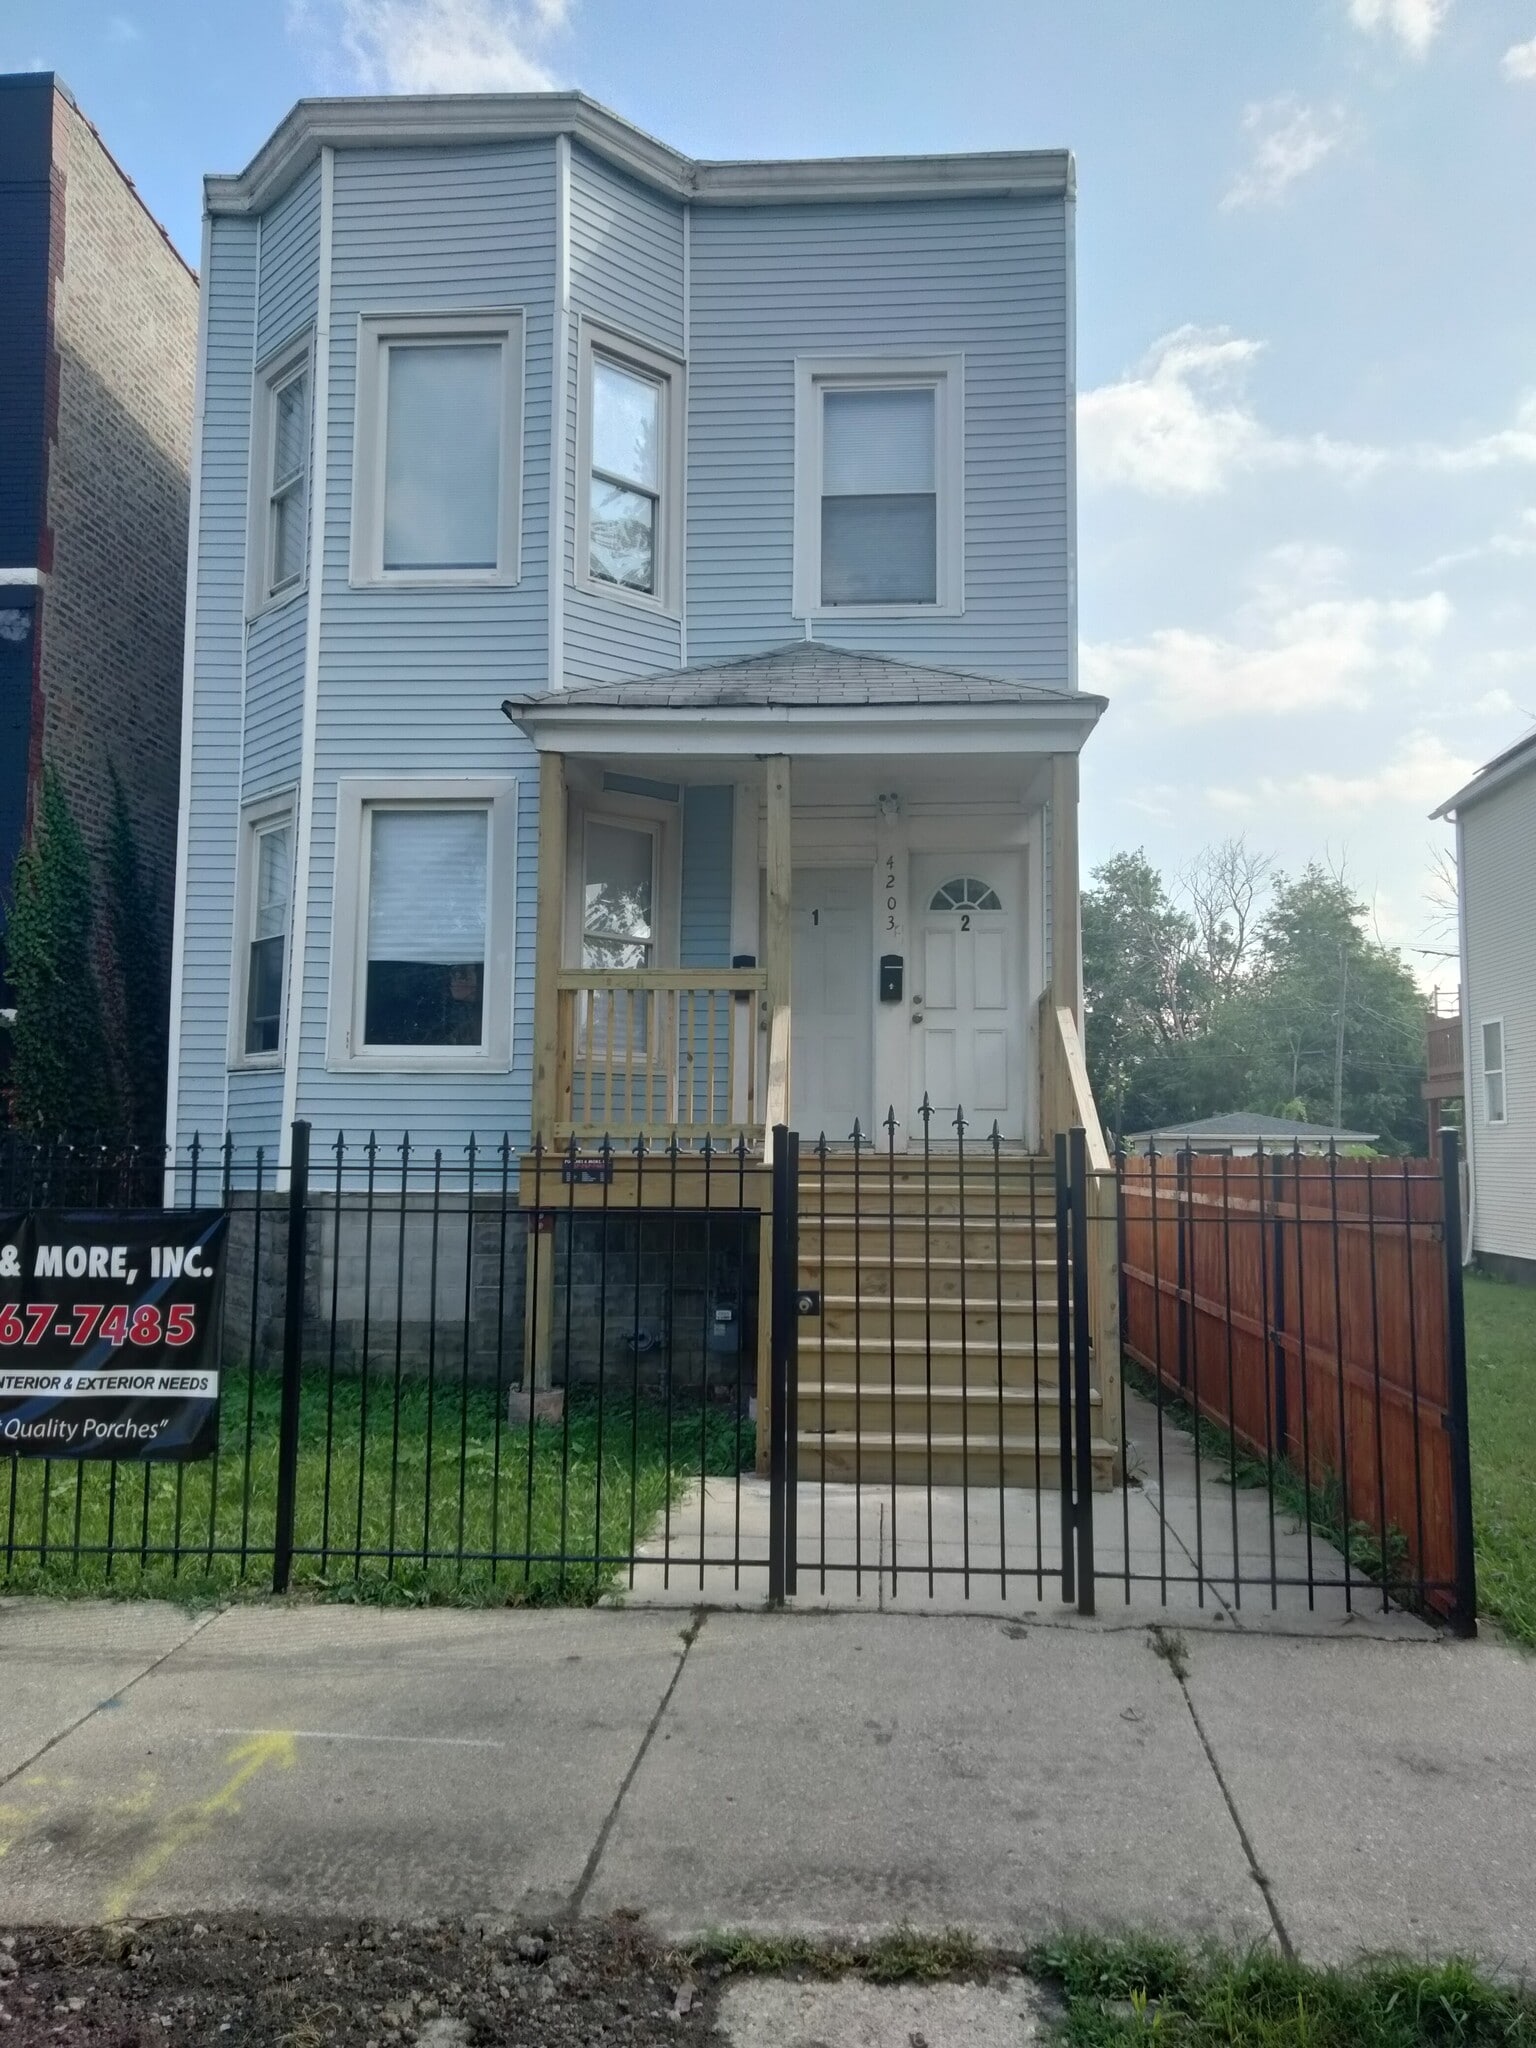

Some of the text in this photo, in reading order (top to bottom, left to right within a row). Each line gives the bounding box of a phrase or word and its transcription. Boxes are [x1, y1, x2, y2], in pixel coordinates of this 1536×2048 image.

[885, 855, 897, 931] 4203
[811, 908, 820, 926] 1
[960, 914, 971, 932] 2
[0, 1244, 214, 1285] & MORE, INC.
[0, 1303, 196, 1346] 67-7485
[63, 1376, 73, 1390] &
[76, 1376, 155, 1390] EXTERIOR
[158, 1376, 209, 1391] NEEDS
[4, 1418, 79, 1442] Quality
